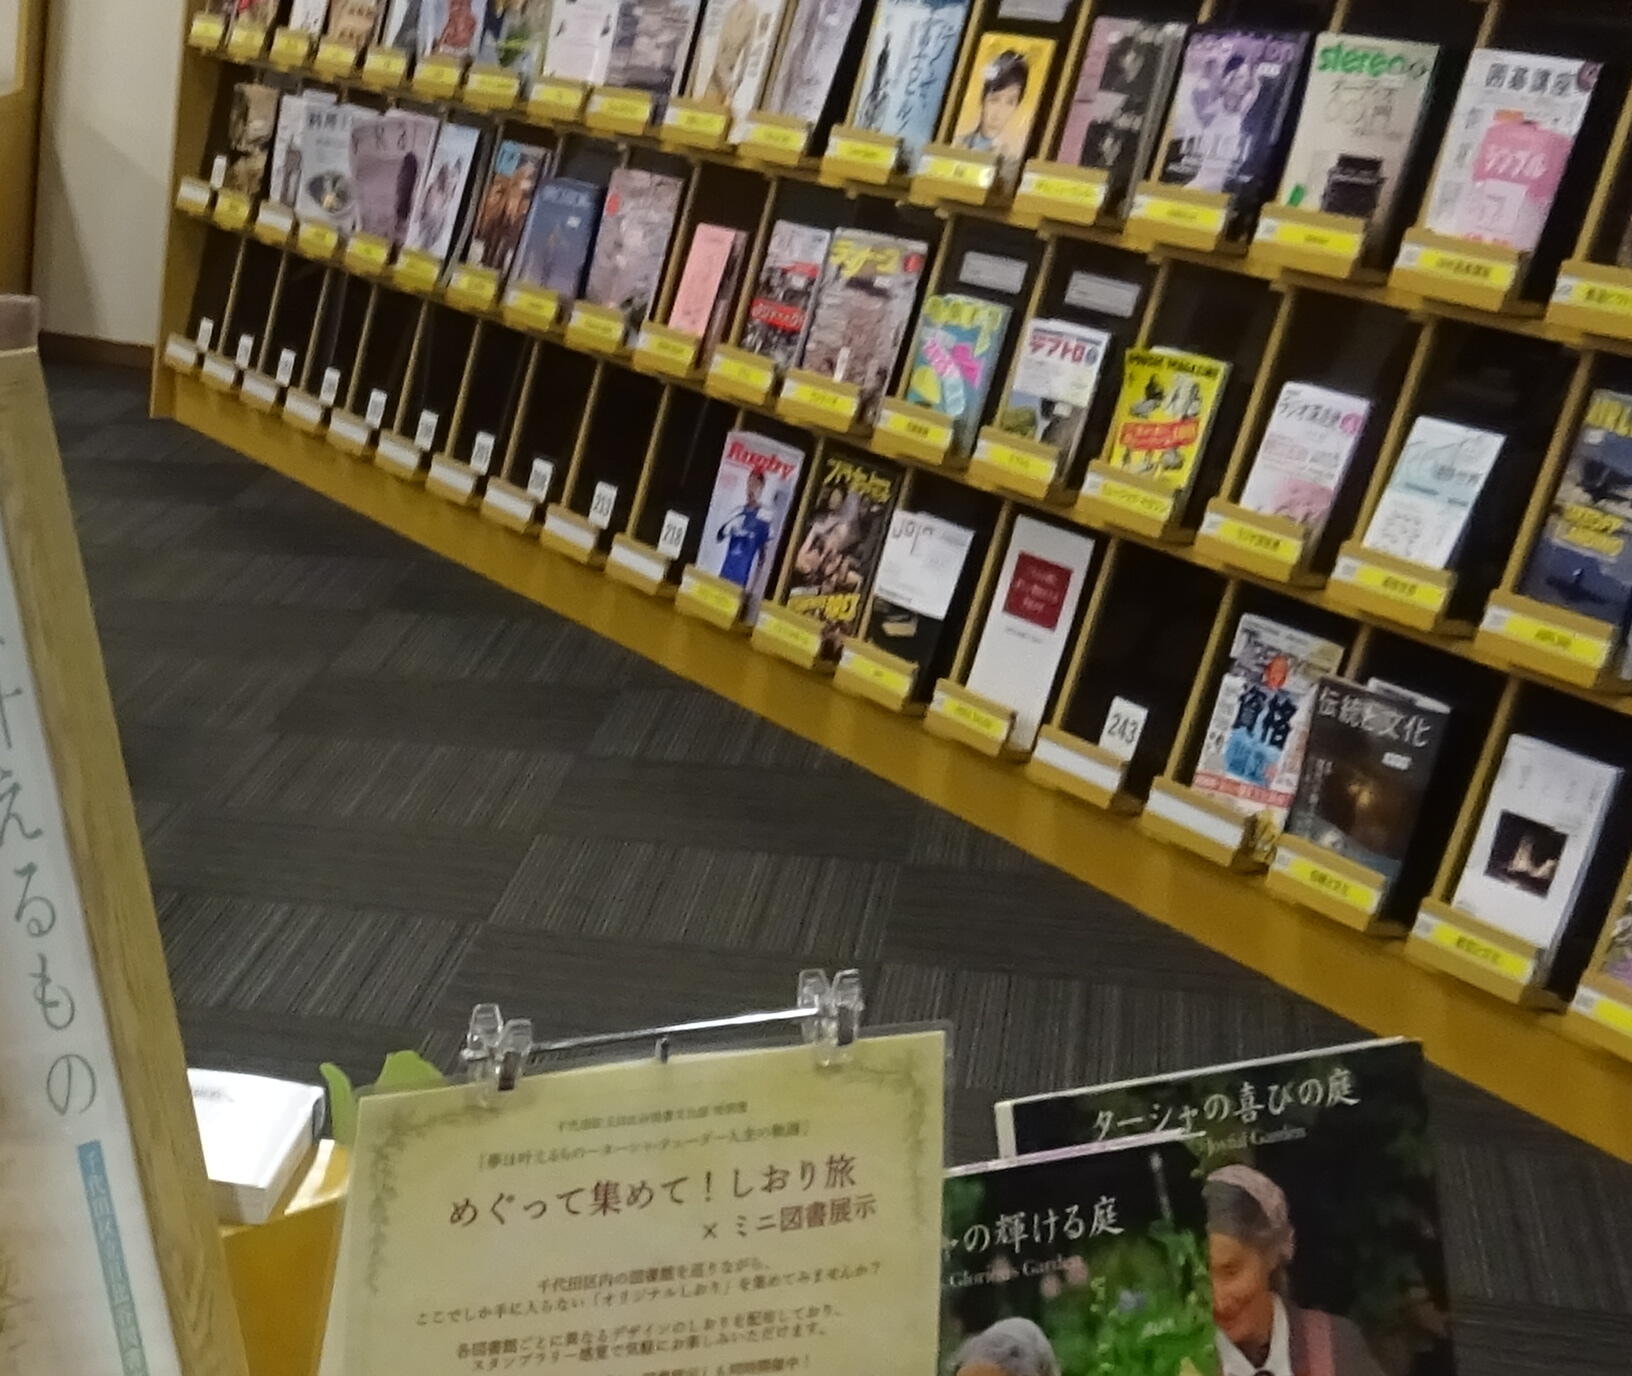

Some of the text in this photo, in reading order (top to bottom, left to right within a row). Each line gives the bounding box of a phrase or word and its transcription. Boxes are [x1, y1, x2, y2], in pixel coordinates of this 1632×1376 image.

[1318, 46, 1405, 77] stereo
[727, 441, 796, 481] Rugby
[661, 523, 683, 547] 218
[1107, 713, 1138, 745] 243
[1318, 686, 1431, 748] 伝統と文化
[1092, 1068, 1360, 1140] ターシャの喜びの庭
[1251, 1125, 1307, 1147] Garden
[446, 1150, 859, 1235] めぐって集めて！しおり旅
[730, 1191, 879, 1240] ミニ図書展示
